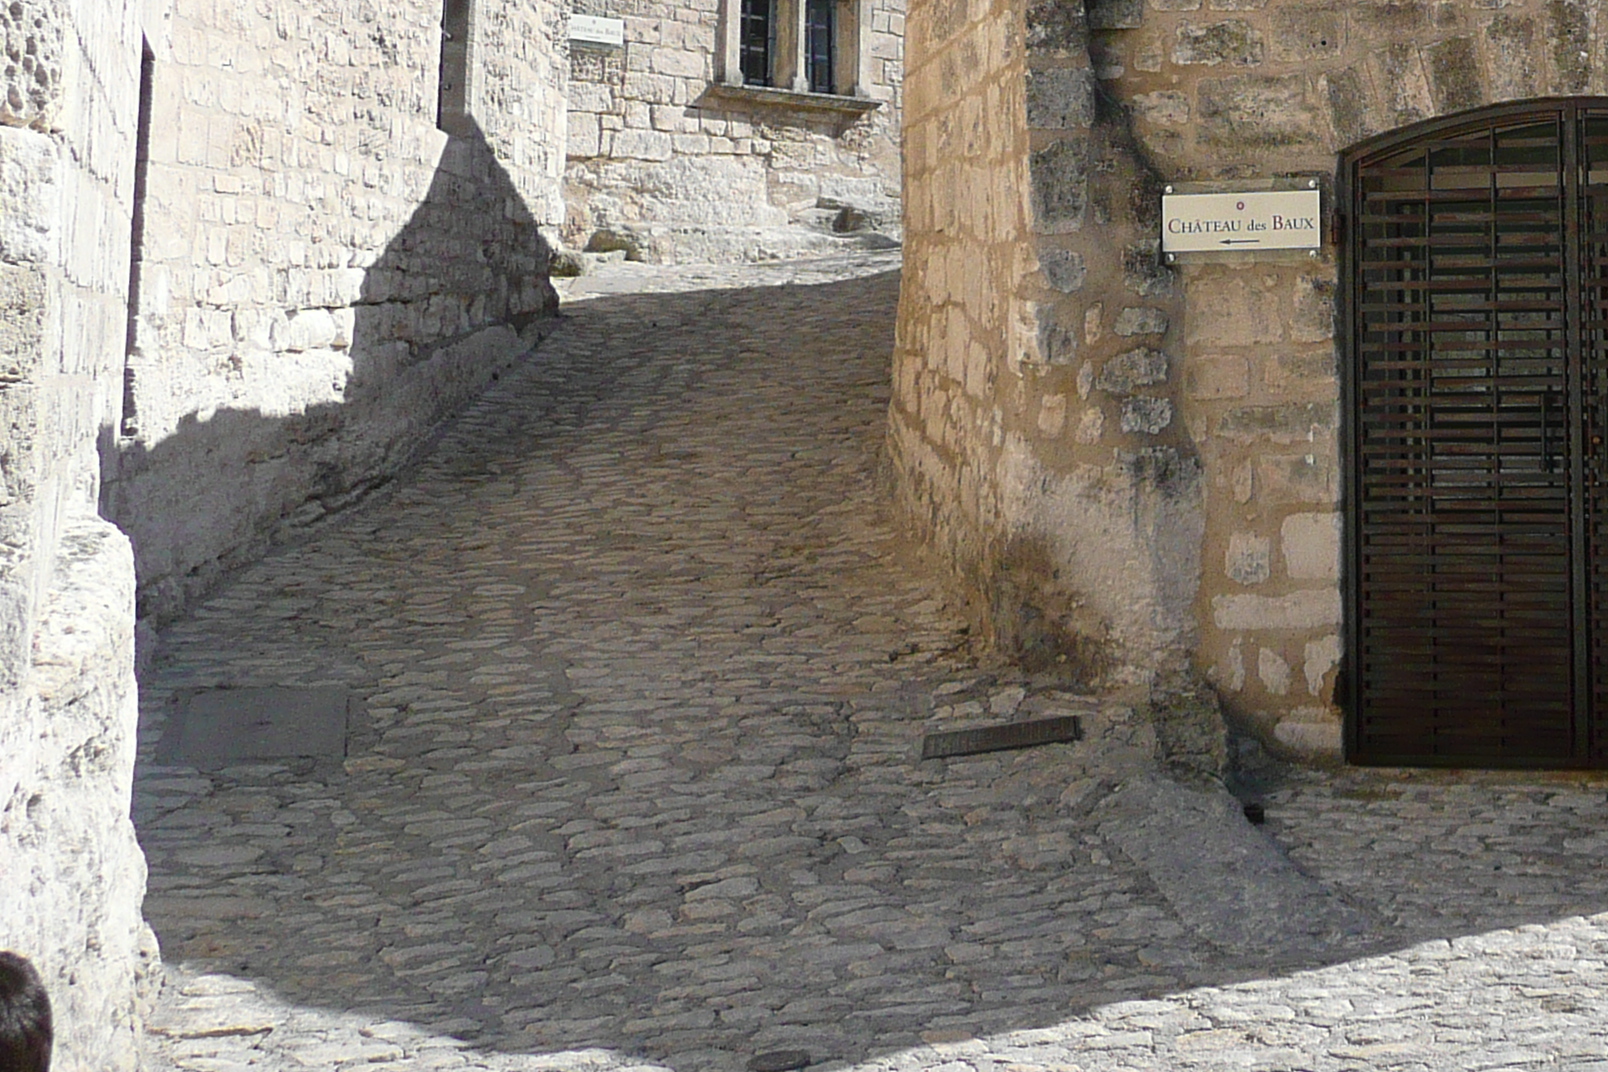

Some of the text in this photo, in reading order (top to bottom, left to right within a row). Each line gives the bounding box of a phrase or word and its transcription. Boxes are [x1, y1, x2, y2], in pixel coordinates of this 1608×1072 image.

[1168, 215, 1314, 234] CHÂTEAU des BAUX
